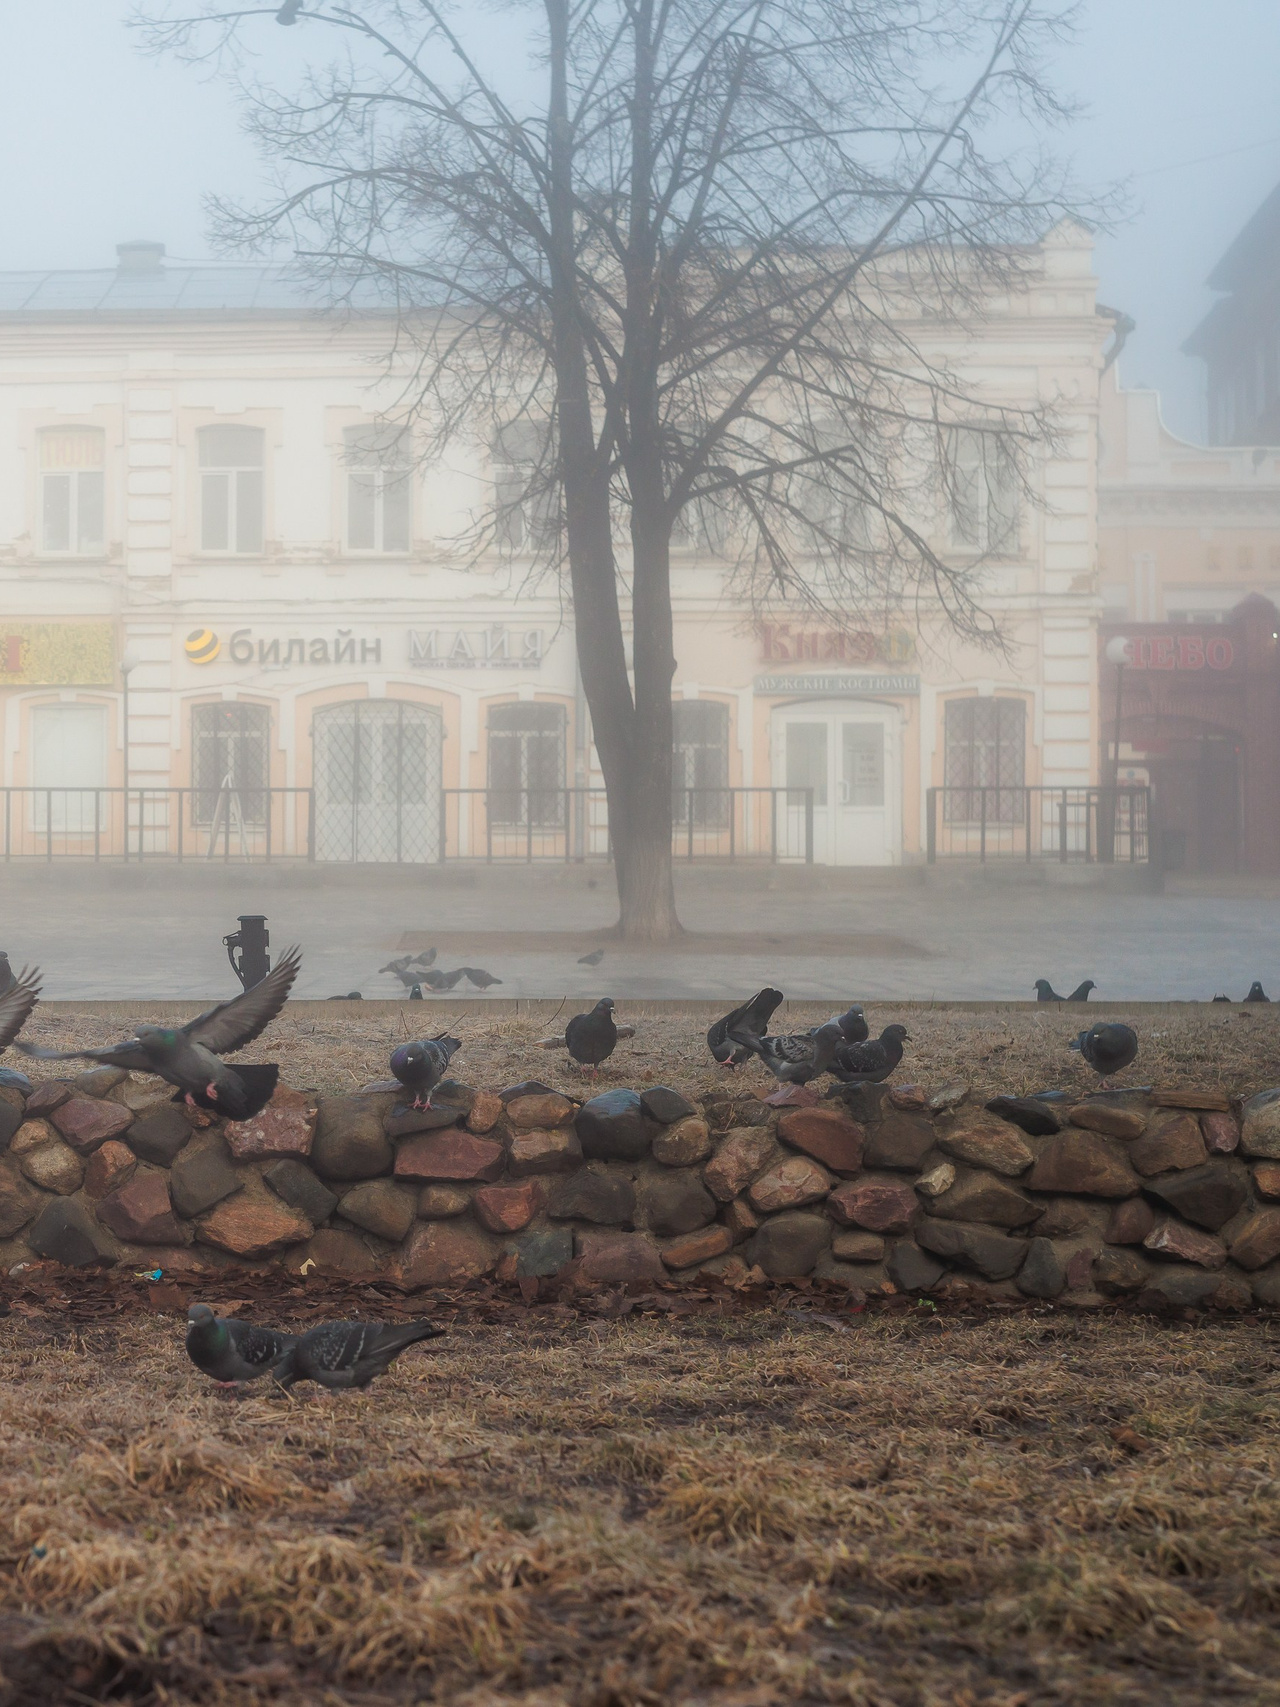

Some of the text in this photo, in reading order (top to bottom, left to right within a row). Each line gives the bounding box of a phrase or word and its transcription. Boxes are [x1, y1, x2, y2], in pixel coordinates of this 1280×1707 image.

[228, 628, 381, 664] билайн
[408, 622, 544, 660] МАЙЯ
[757, 677, 917, 690] МУЖСКИЕ КОСТЮМЫ
